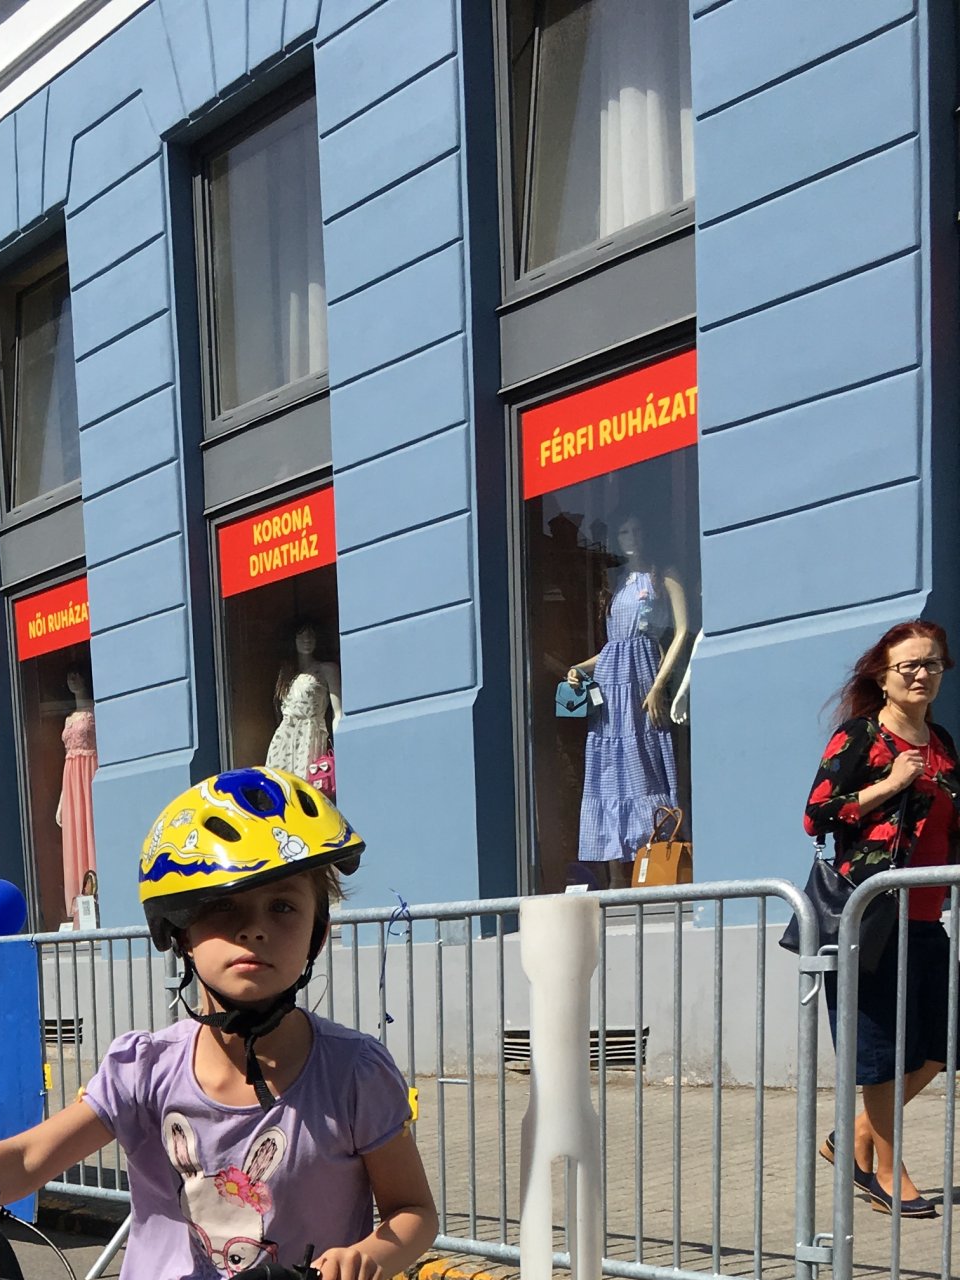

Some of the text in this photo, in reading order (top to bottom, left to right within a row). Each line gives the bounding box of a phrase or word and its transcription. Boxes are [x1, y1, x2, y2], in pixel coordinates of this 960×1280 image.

[540, 386, 698, 468] FÉRFI RUHÁZAT
[253, 504, 313, 546] KORONA
[249, 529, 319, 577] DIVATHÁZ
[28, 600, 90, 639] NŐI RUHÁZA
